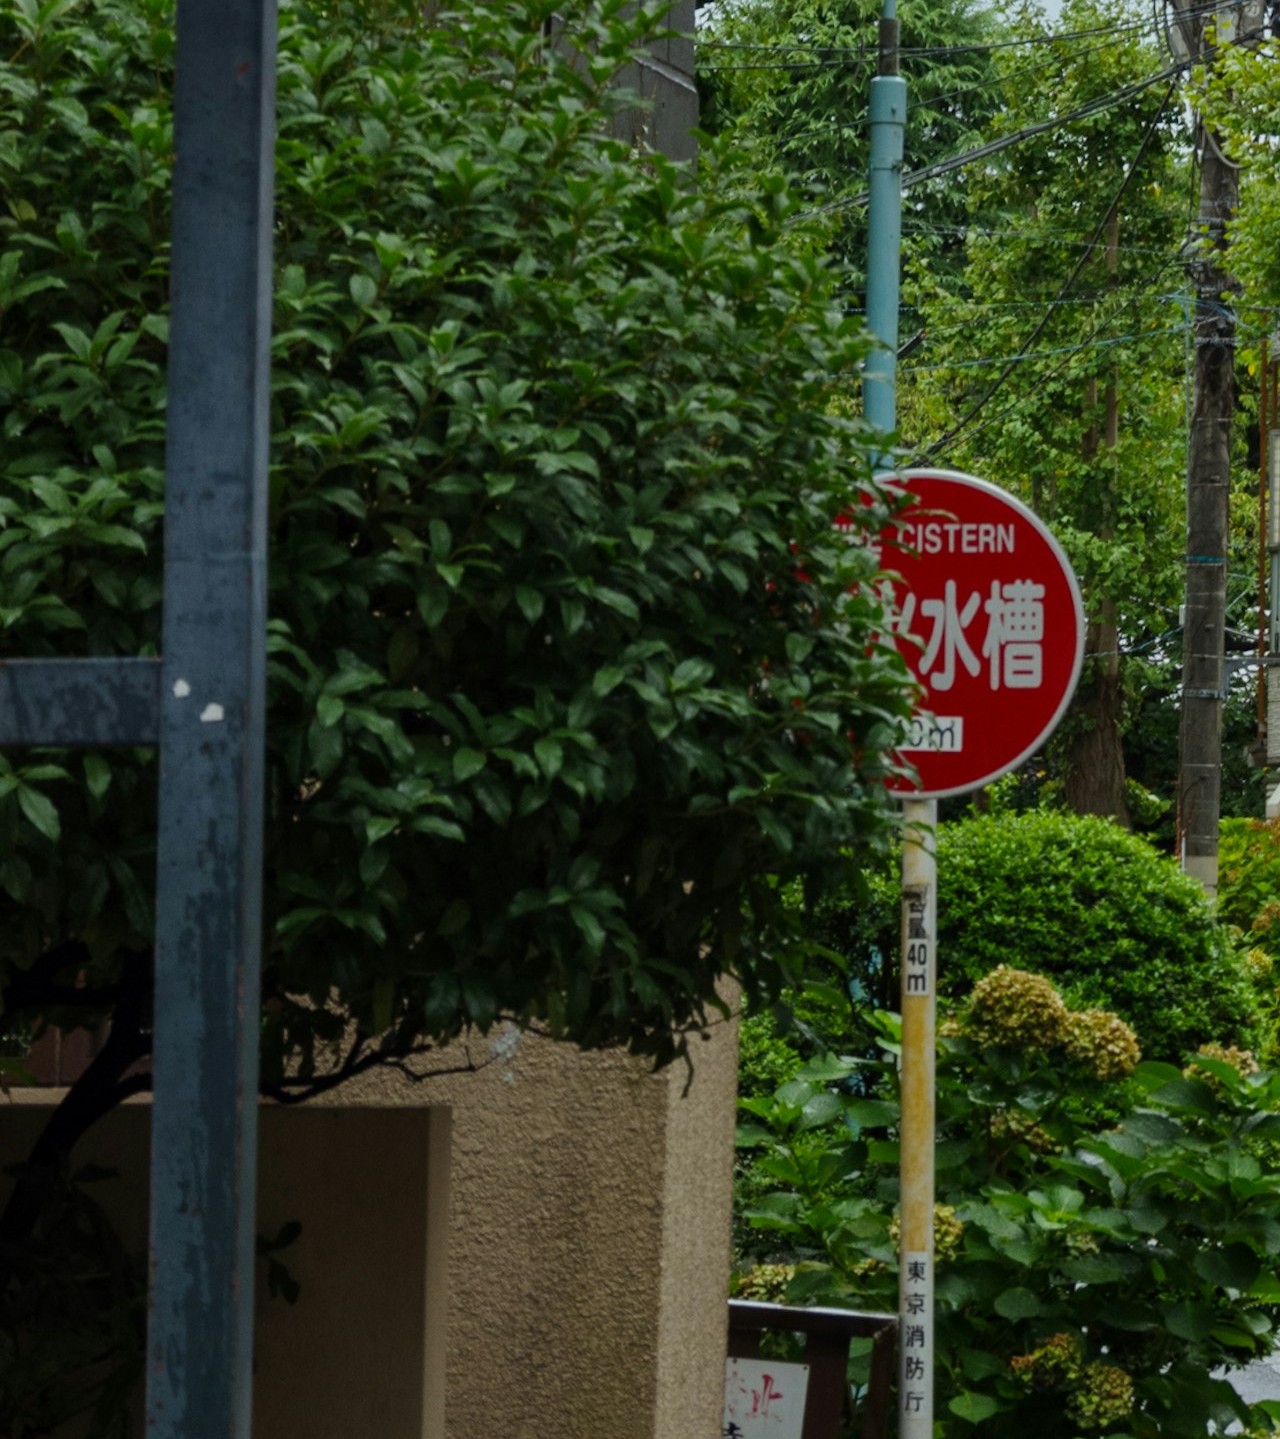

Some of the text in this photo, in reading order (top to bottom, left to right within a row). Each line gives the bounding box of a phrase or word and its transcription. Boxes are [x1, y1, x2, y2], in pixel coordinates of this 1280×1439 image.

[897, 523, 1015, 554] CISTERN
[907, 943, 928, 966] 40
[904, 1261, 927, 1414] 東京消防庁
